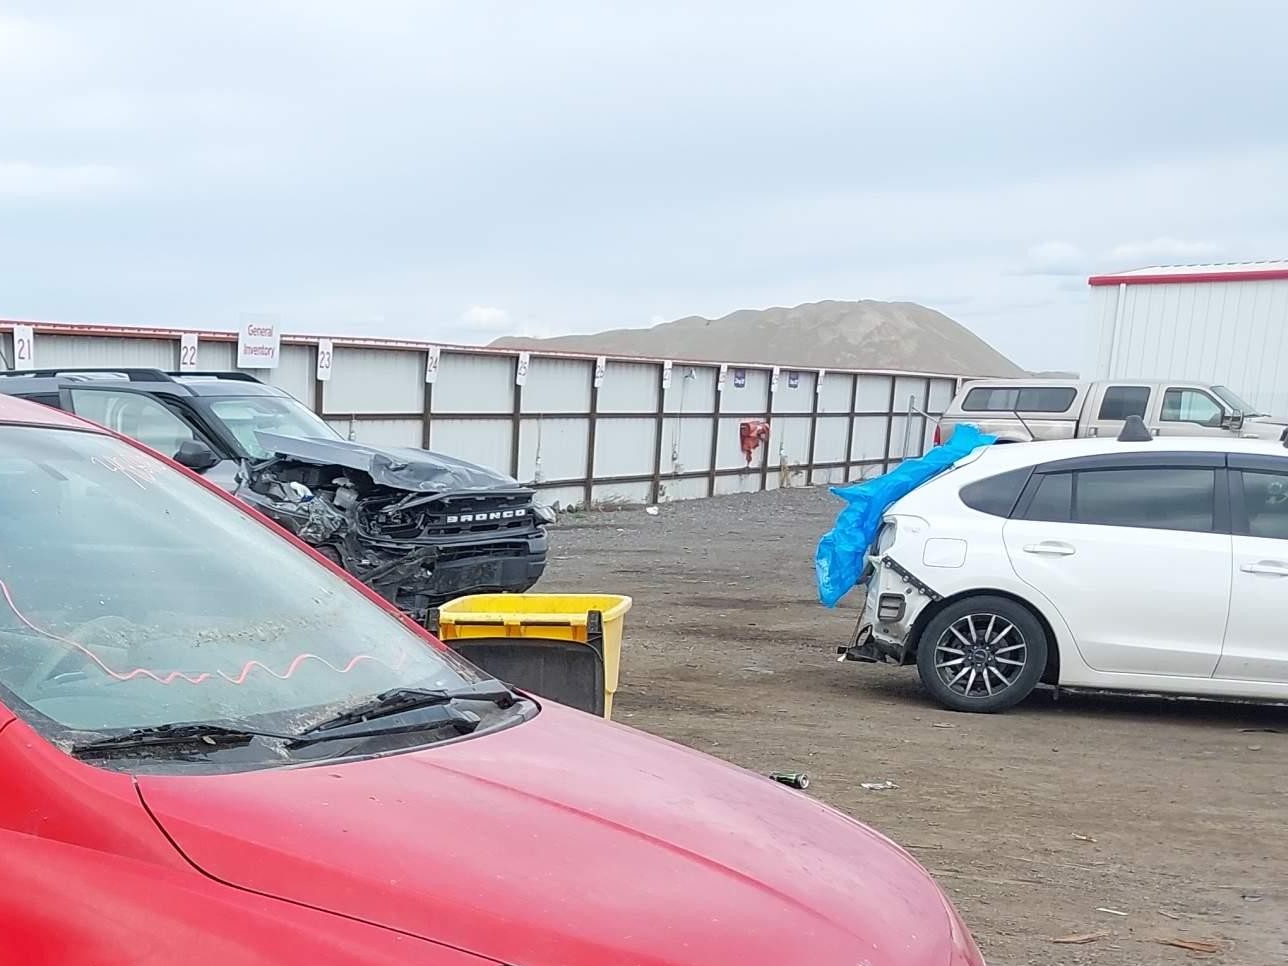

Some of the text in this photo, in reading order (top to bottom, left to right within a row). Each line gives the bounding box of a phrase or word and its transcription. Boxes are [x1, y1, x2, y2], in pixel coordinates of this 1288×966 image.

[247, 324, 274, 337] General
[17, 338, 31, 360] 21
[181, 345, 196, 365] 22
[243, 344, 275, 358] Inventory
[319, 350, 331, 369] 23
[428, 356, 438, 372] 24
[447, 509, 526, 523] BRONCO
